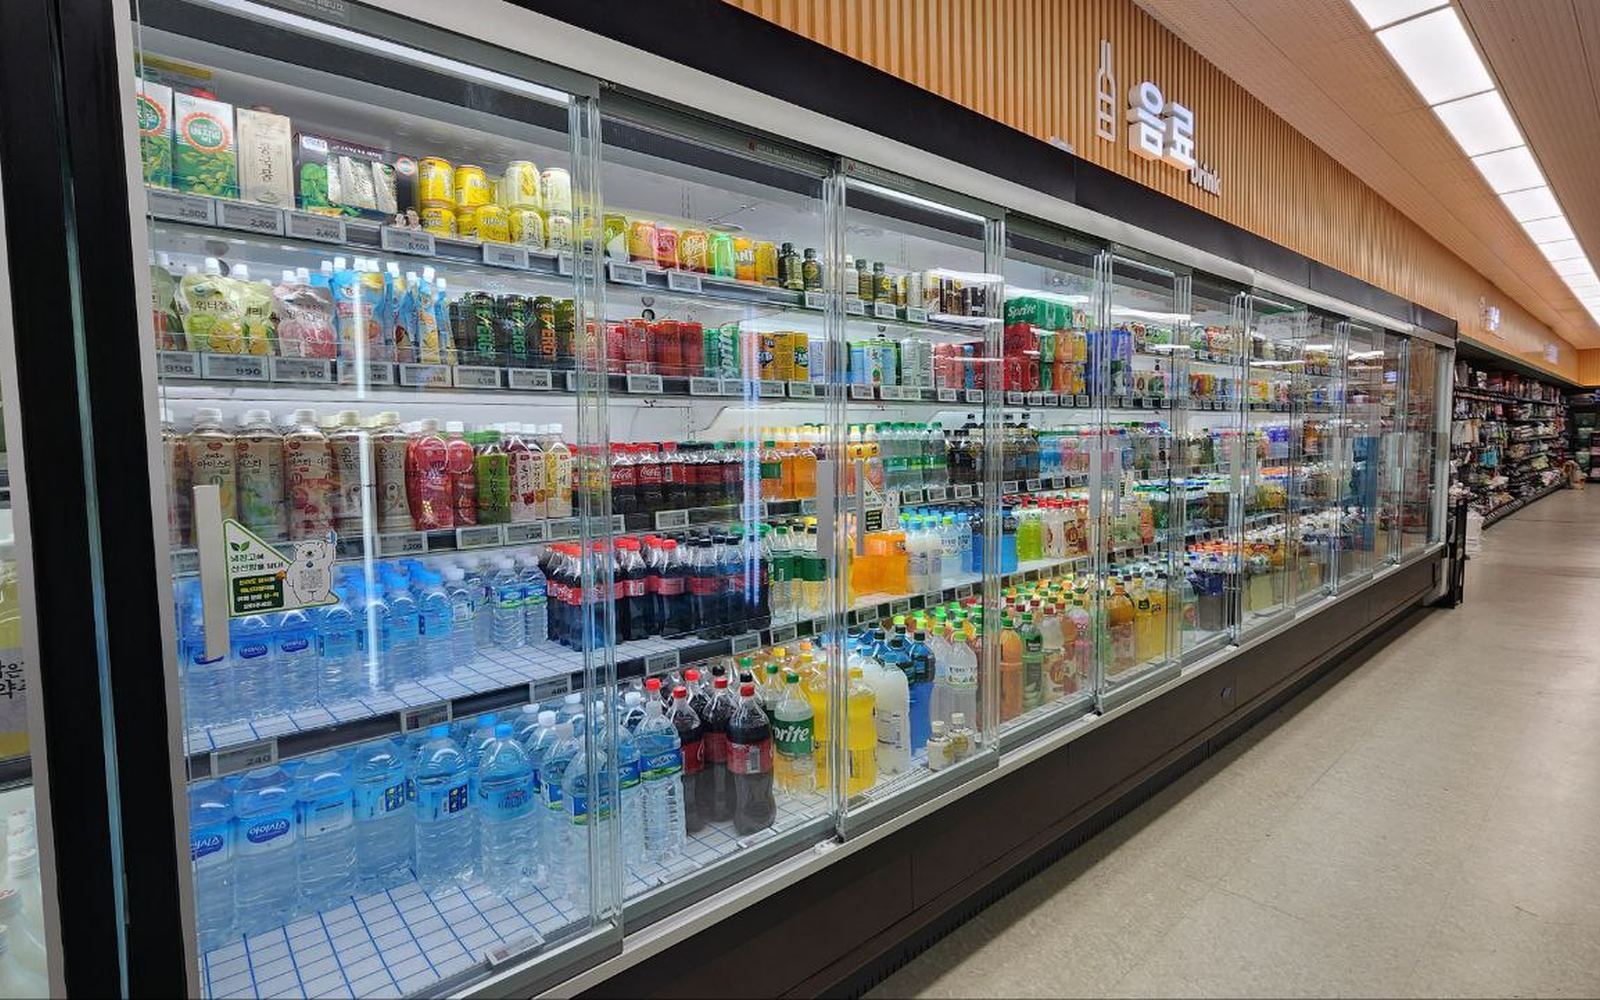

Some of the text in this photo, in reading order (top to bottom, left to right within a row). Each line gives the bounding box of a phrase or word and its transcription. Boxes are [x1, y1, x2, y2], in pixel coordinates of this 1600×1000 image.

[1128, 81, 1197, 170] 음료
[1190, 162, 1222, 197] Drink
[1007, 303, 1037, 318] Sprite
